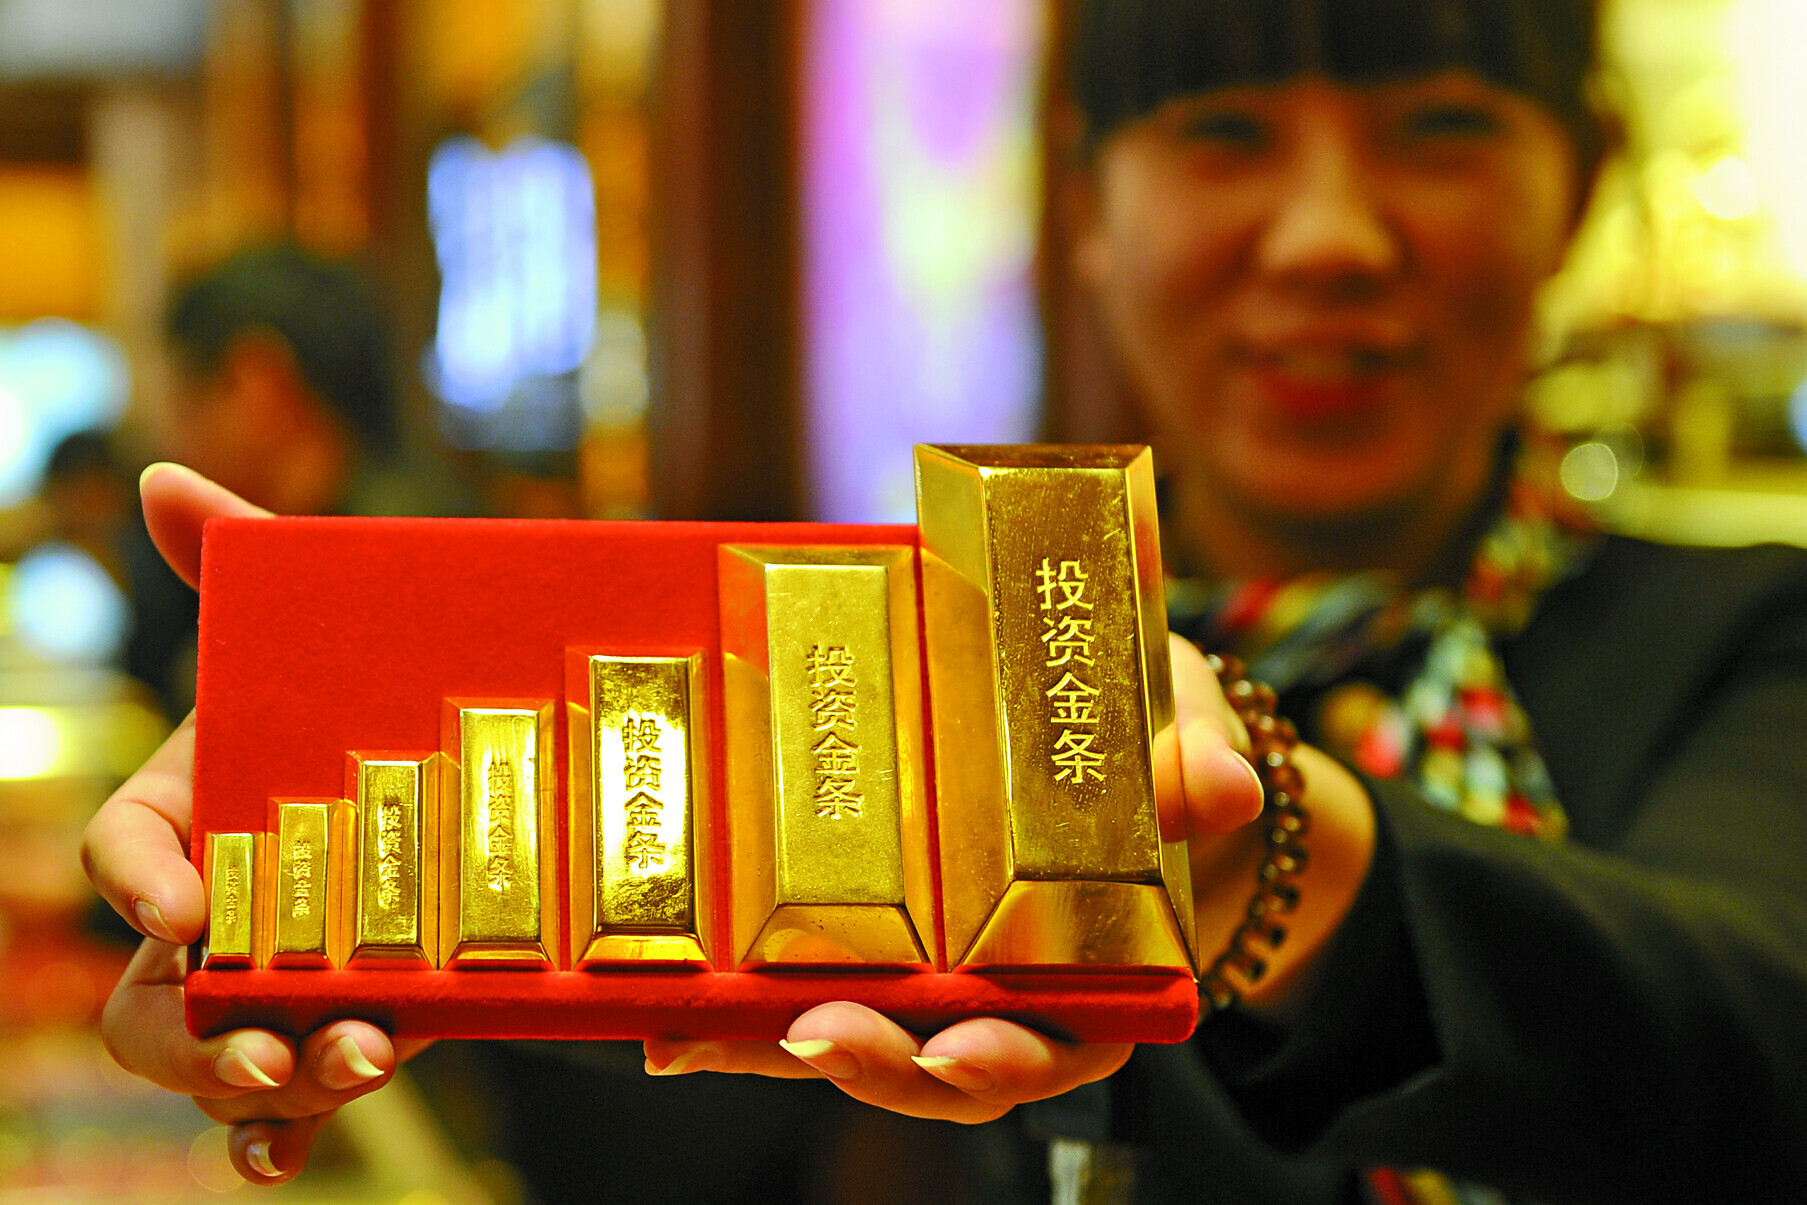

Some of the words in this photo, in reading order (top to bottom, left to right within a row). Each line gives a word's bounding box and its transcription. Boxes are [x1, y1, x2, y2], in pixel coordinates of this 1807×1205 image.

[806, 645, 864, 820] 投资金条
[1035, 557, 1107, 784] 投资金条
[377, 801, 403, 910] 投资金条
[487, 760, 514, 892] 投资金条
[621, 717, 666, 869] 投资金条
